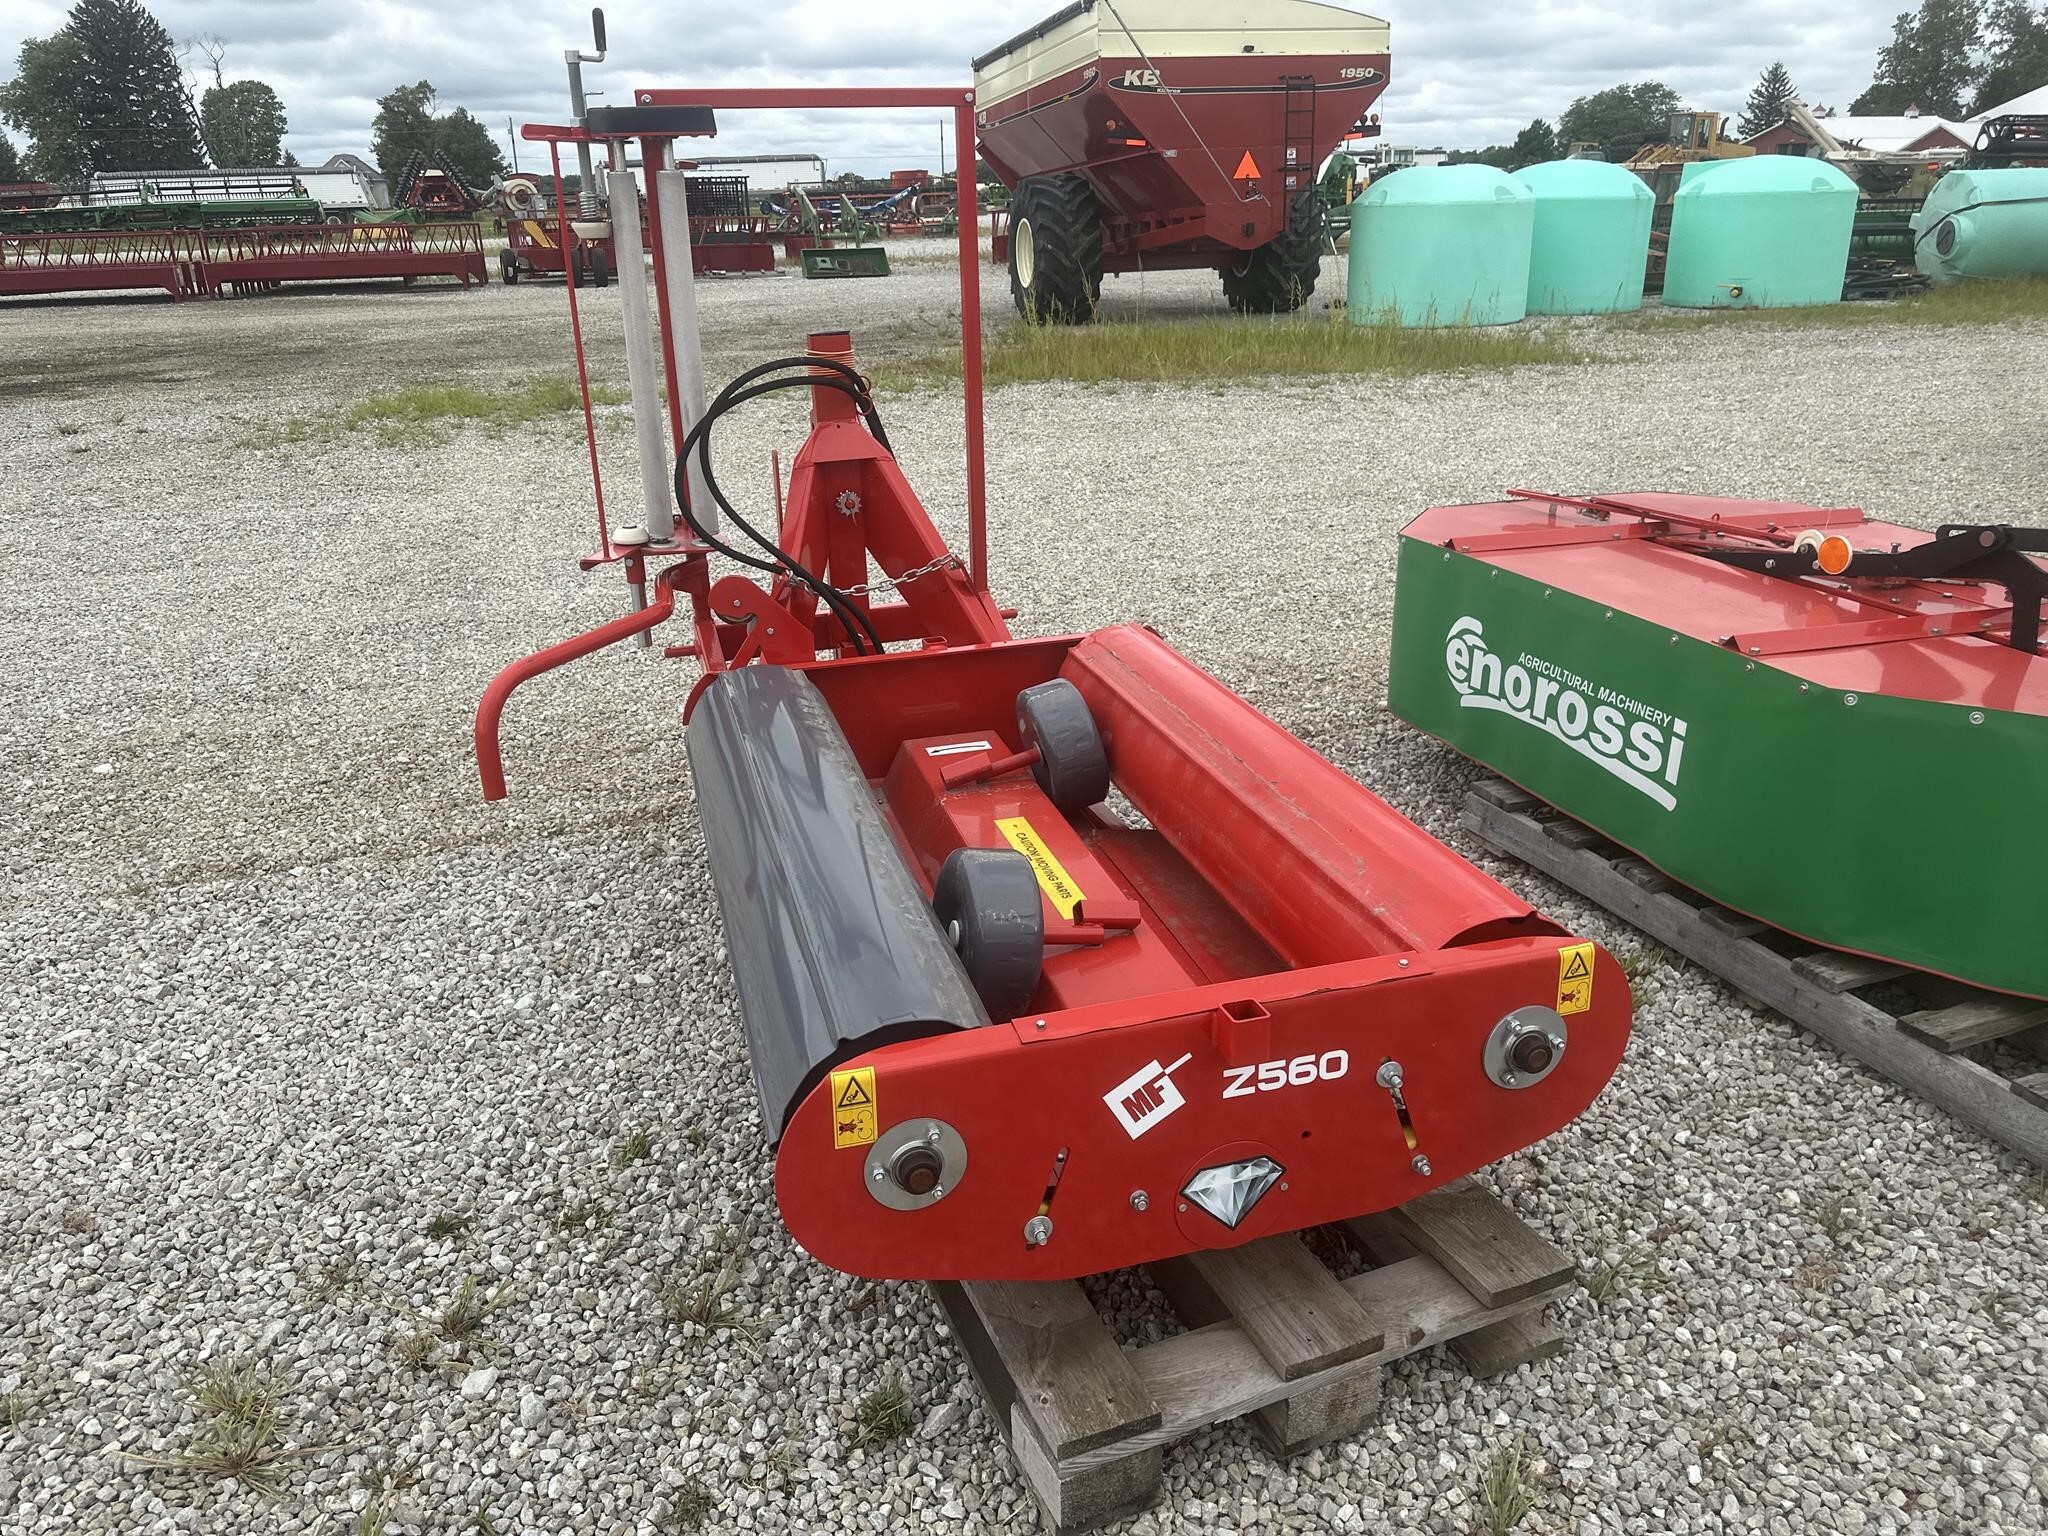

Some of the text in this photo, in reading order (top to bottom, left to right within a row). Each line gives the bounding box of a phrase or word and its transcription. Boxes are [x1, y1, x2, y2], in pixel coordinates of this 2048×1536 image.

[1123, 69, 1160, 87] KB
[1340, 67, 1375, 78] 1950
[1446, 616, 1688, 786] enorossi
[1518, 652, 1672, 727] AGRICULTURAL MACHINERY
[1035, 857, 1059, 882] MOVING
[1053, 881, 1072, 899] PARTS
[1223, 1050, 1349, 1099] Z560
[1120, 1078, 1165, 1123] MF
